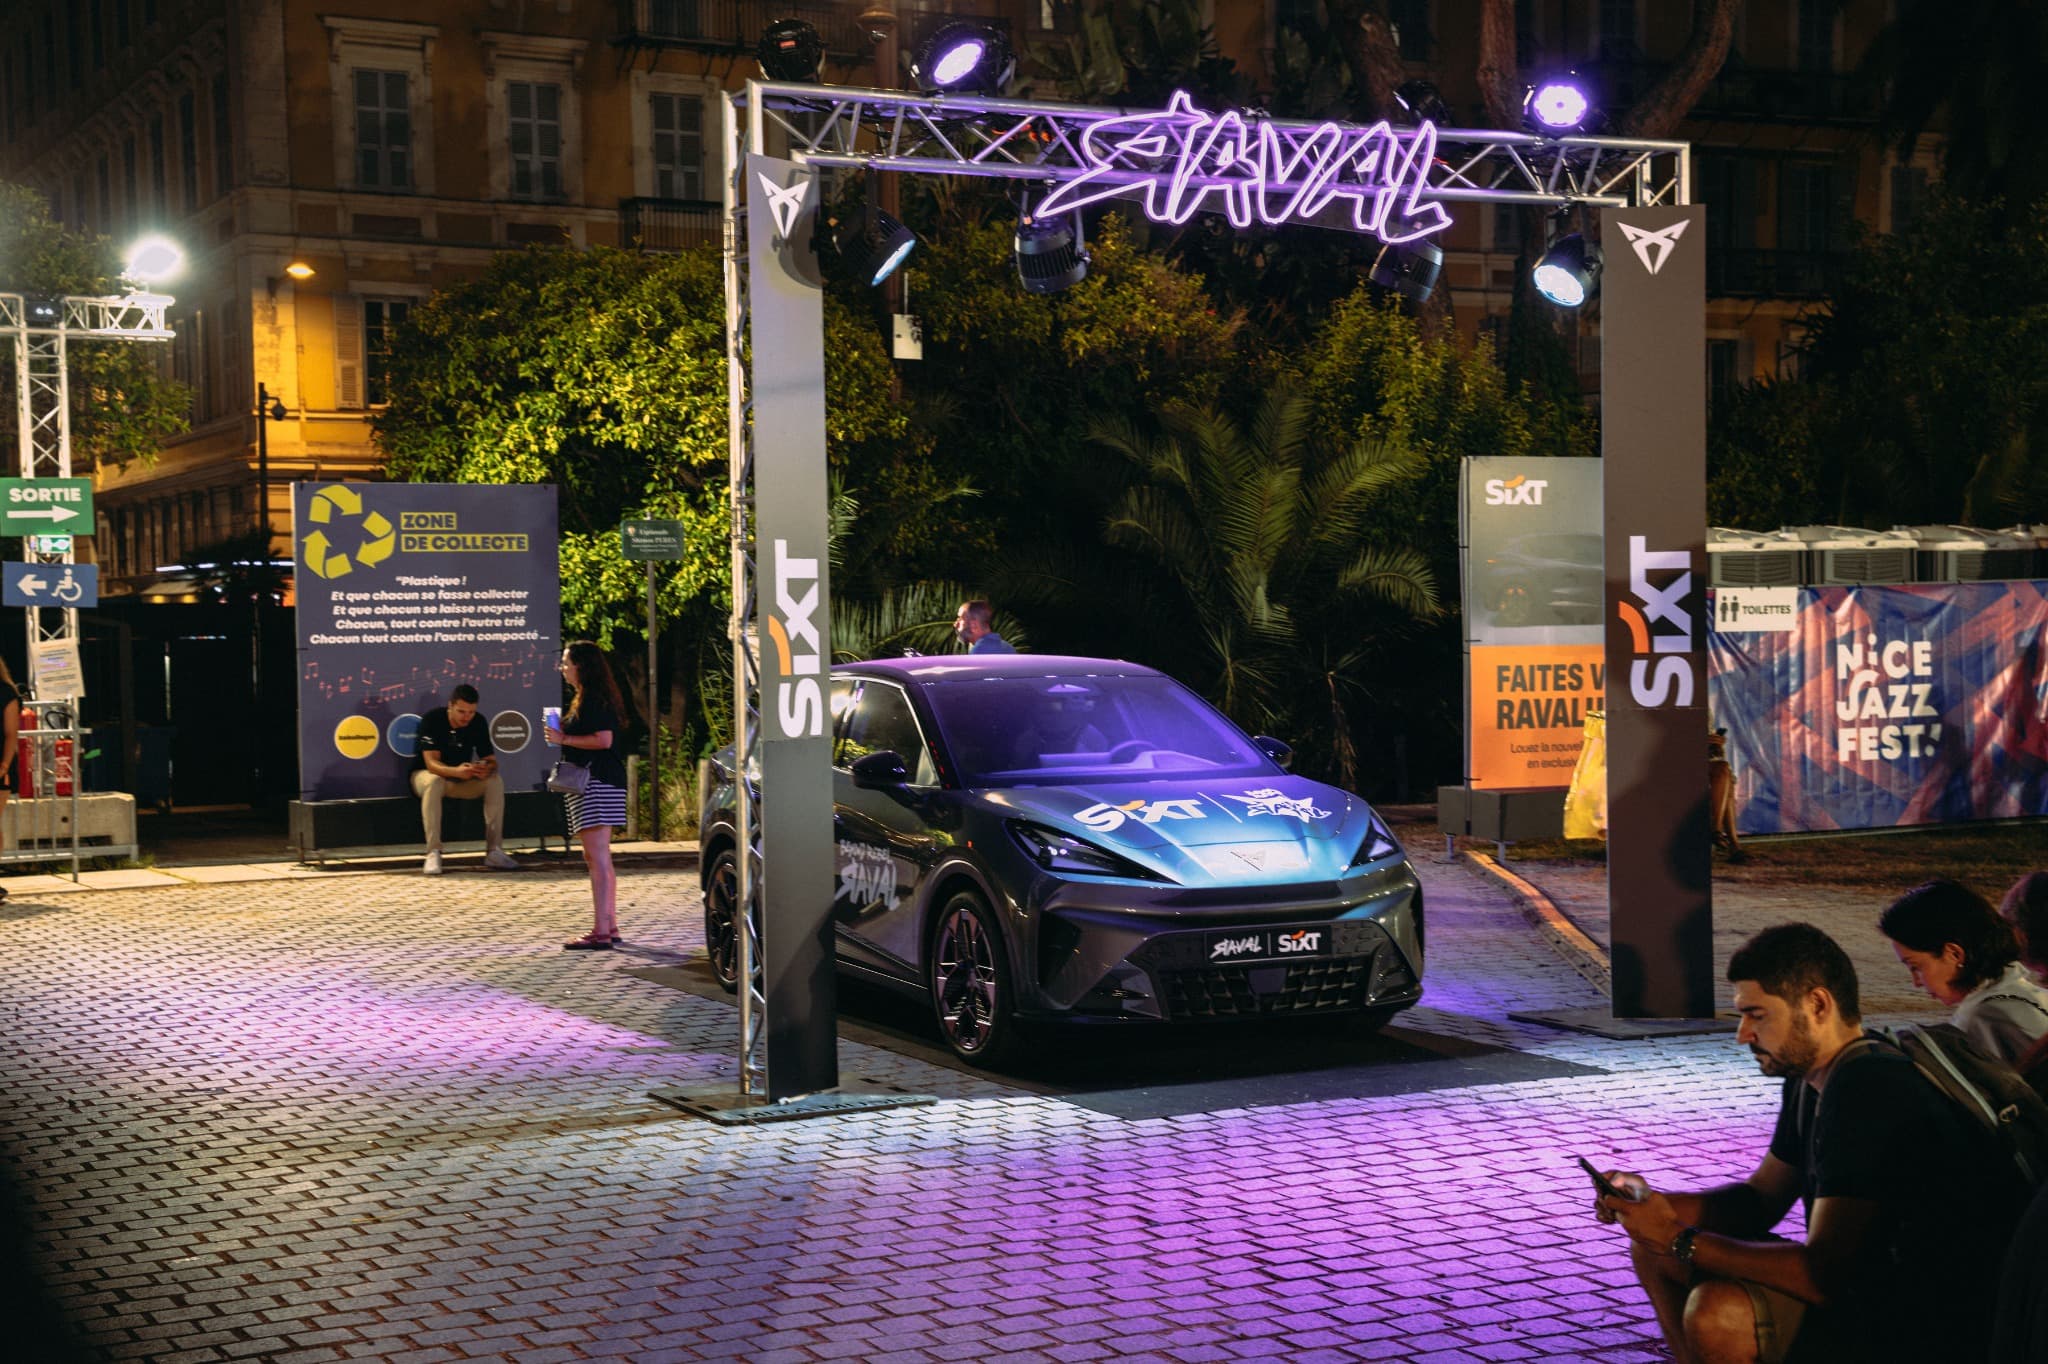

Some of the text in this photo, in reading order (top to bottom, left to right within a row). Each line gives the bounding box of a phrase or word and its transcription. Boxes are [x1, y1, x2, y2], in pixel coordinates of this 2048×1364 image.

[9, 487, 82, 503] SORTIE
[403, 514, 455, 529] ZONE
[404, 535, 526, 550] DE COLLECTE
[331, 589, 529, 603] Et que chacun se fasse collecter
[332, 603, 528, 617] Et que chacun se laisse recycler
[1742, 604, 1791, 615] TOILETTES
[335, 619, 389, 631] Chacun,
[390, 619, 417, 629] tout
[418, 618, 460, 629] contre
[503, 616, 526, 627] trié
[309, 634, 360, 645] Chacun
[361, 633, 389, 644] tout
[390, 632, 433, 643] contre
[476, 629, 539, 643] compacté
[1496, 664, 1584, 693] FAITES
[1836, 669, 1939, 722] JAZZ
[1510, 743, 1538, 754] Louez
[1541, 742, 1550, 752] la
[1527, 760, 1540, 769] en
